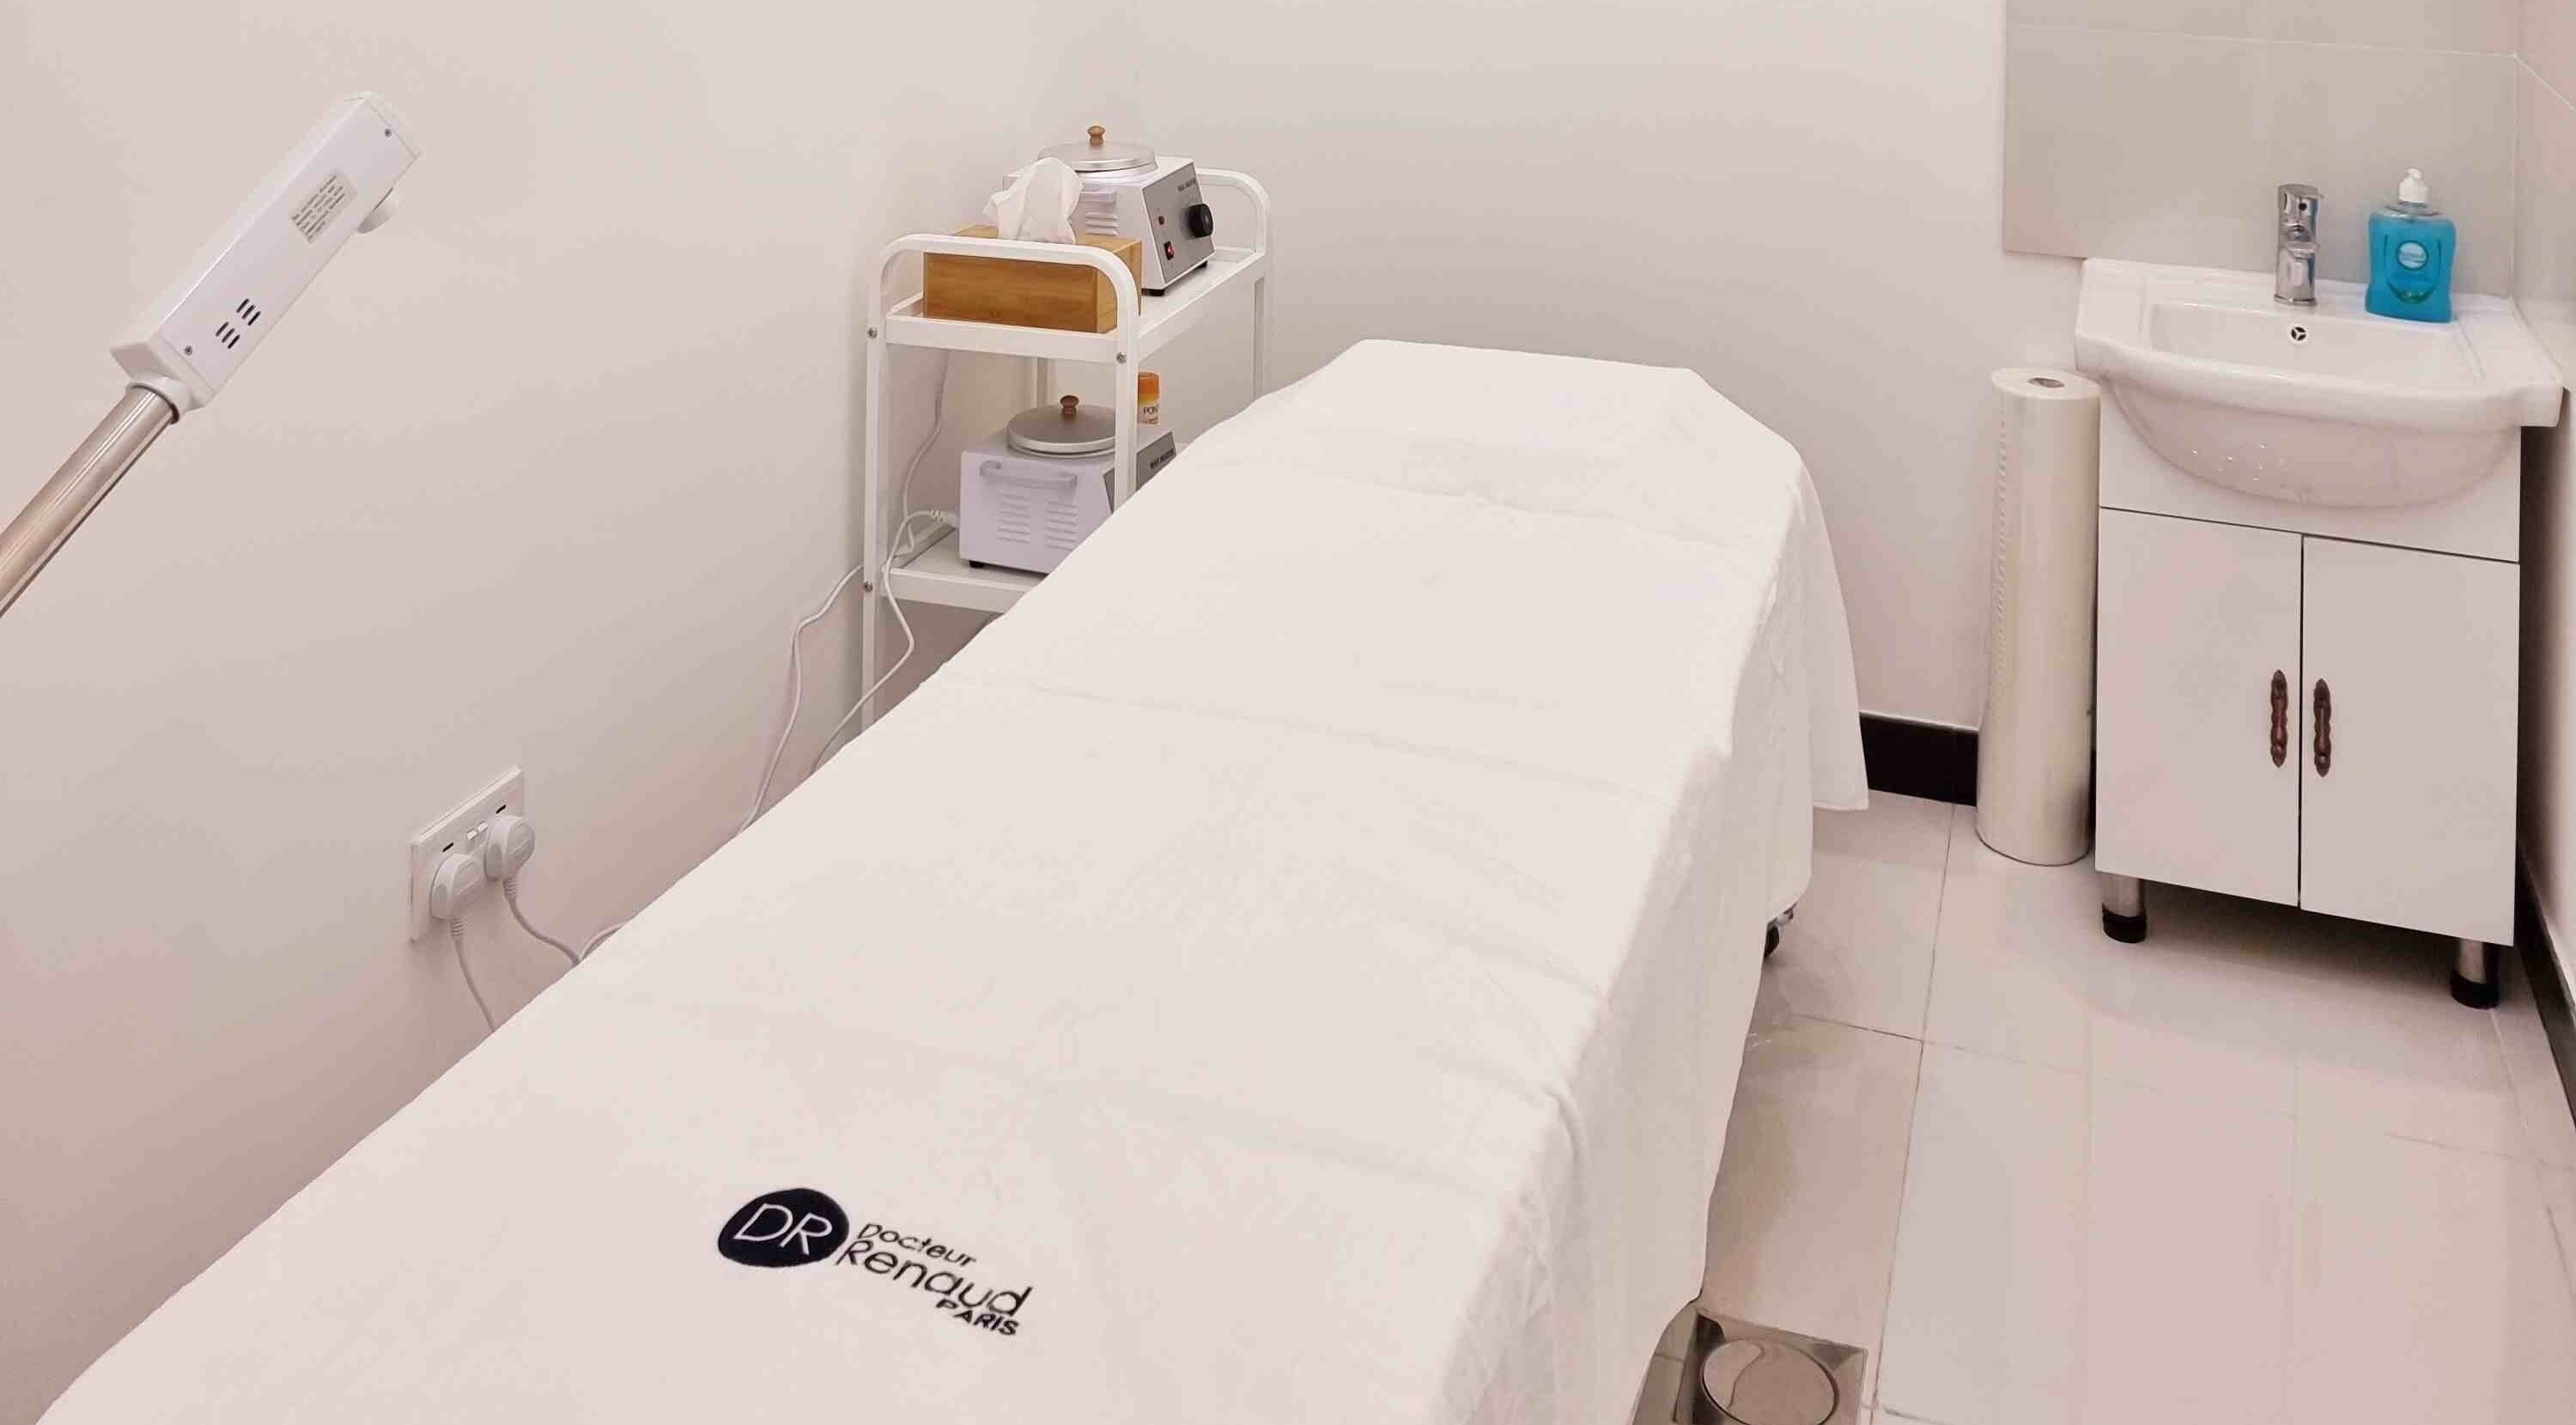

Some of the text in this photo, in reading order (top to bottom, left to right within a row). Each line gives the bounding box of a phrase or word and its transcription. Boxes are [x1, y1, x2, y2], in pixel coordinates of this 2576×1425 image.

[734, 1203, 833, 1255] DR
[858, 1223, 977, 1267] Docteur
[835, 1239, 1033, 1316] Renaud
[935, 1298, 1020, 1336] PARIS
